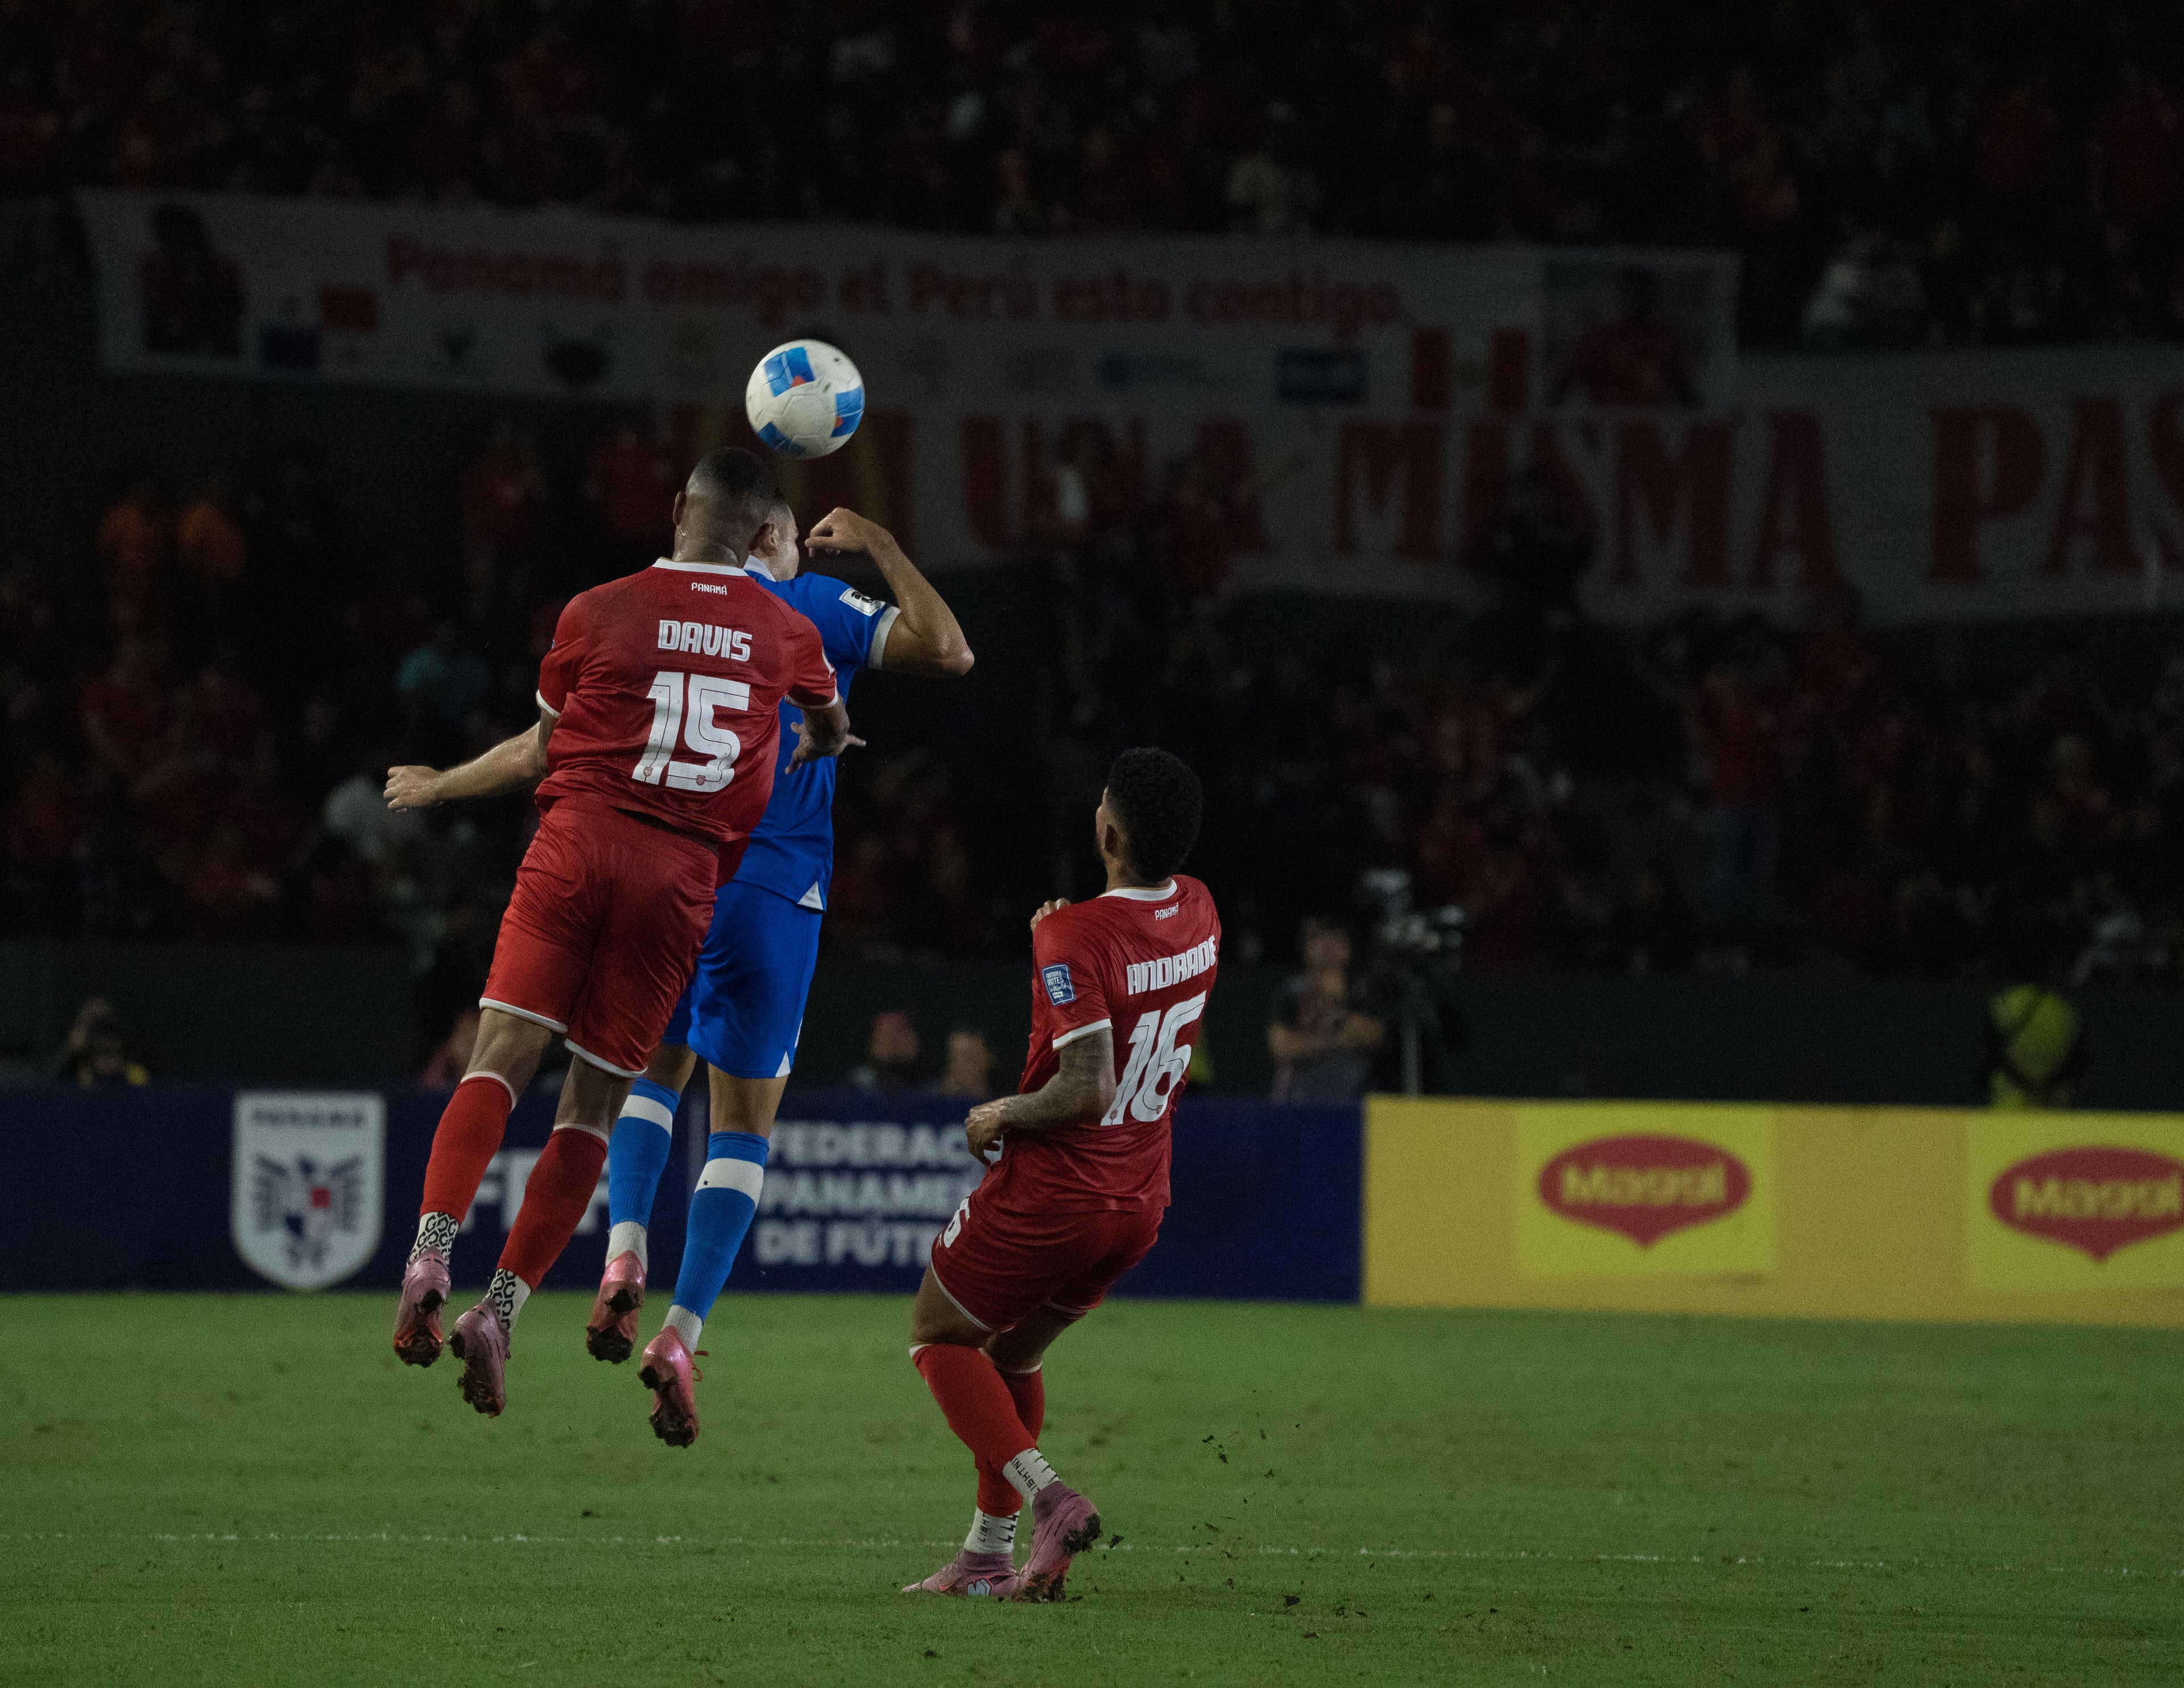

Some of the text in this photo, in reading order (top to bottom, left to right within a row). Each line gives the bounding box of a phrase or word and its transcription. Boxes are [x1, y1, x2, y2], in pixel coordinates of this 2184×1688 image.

[642, 248, 827, 329] amigo
[838, 256, 892, 316] el
[907, 254, 1040, 321] Perú
[691, 582, 727, 595] PANAMÁ
[657, 620, 753, 662] DAVIS
[631, 671, 751, 793] 15
[1155, 902, 1179, 921] PANAMÁ
[1127, 934, 1217, 995] ANDRADE
[1100, 990, 1207, 1127] 16
[768, 1119, 970, 1168] FEDERAC
[754, 1219, 821, 1267] DE
